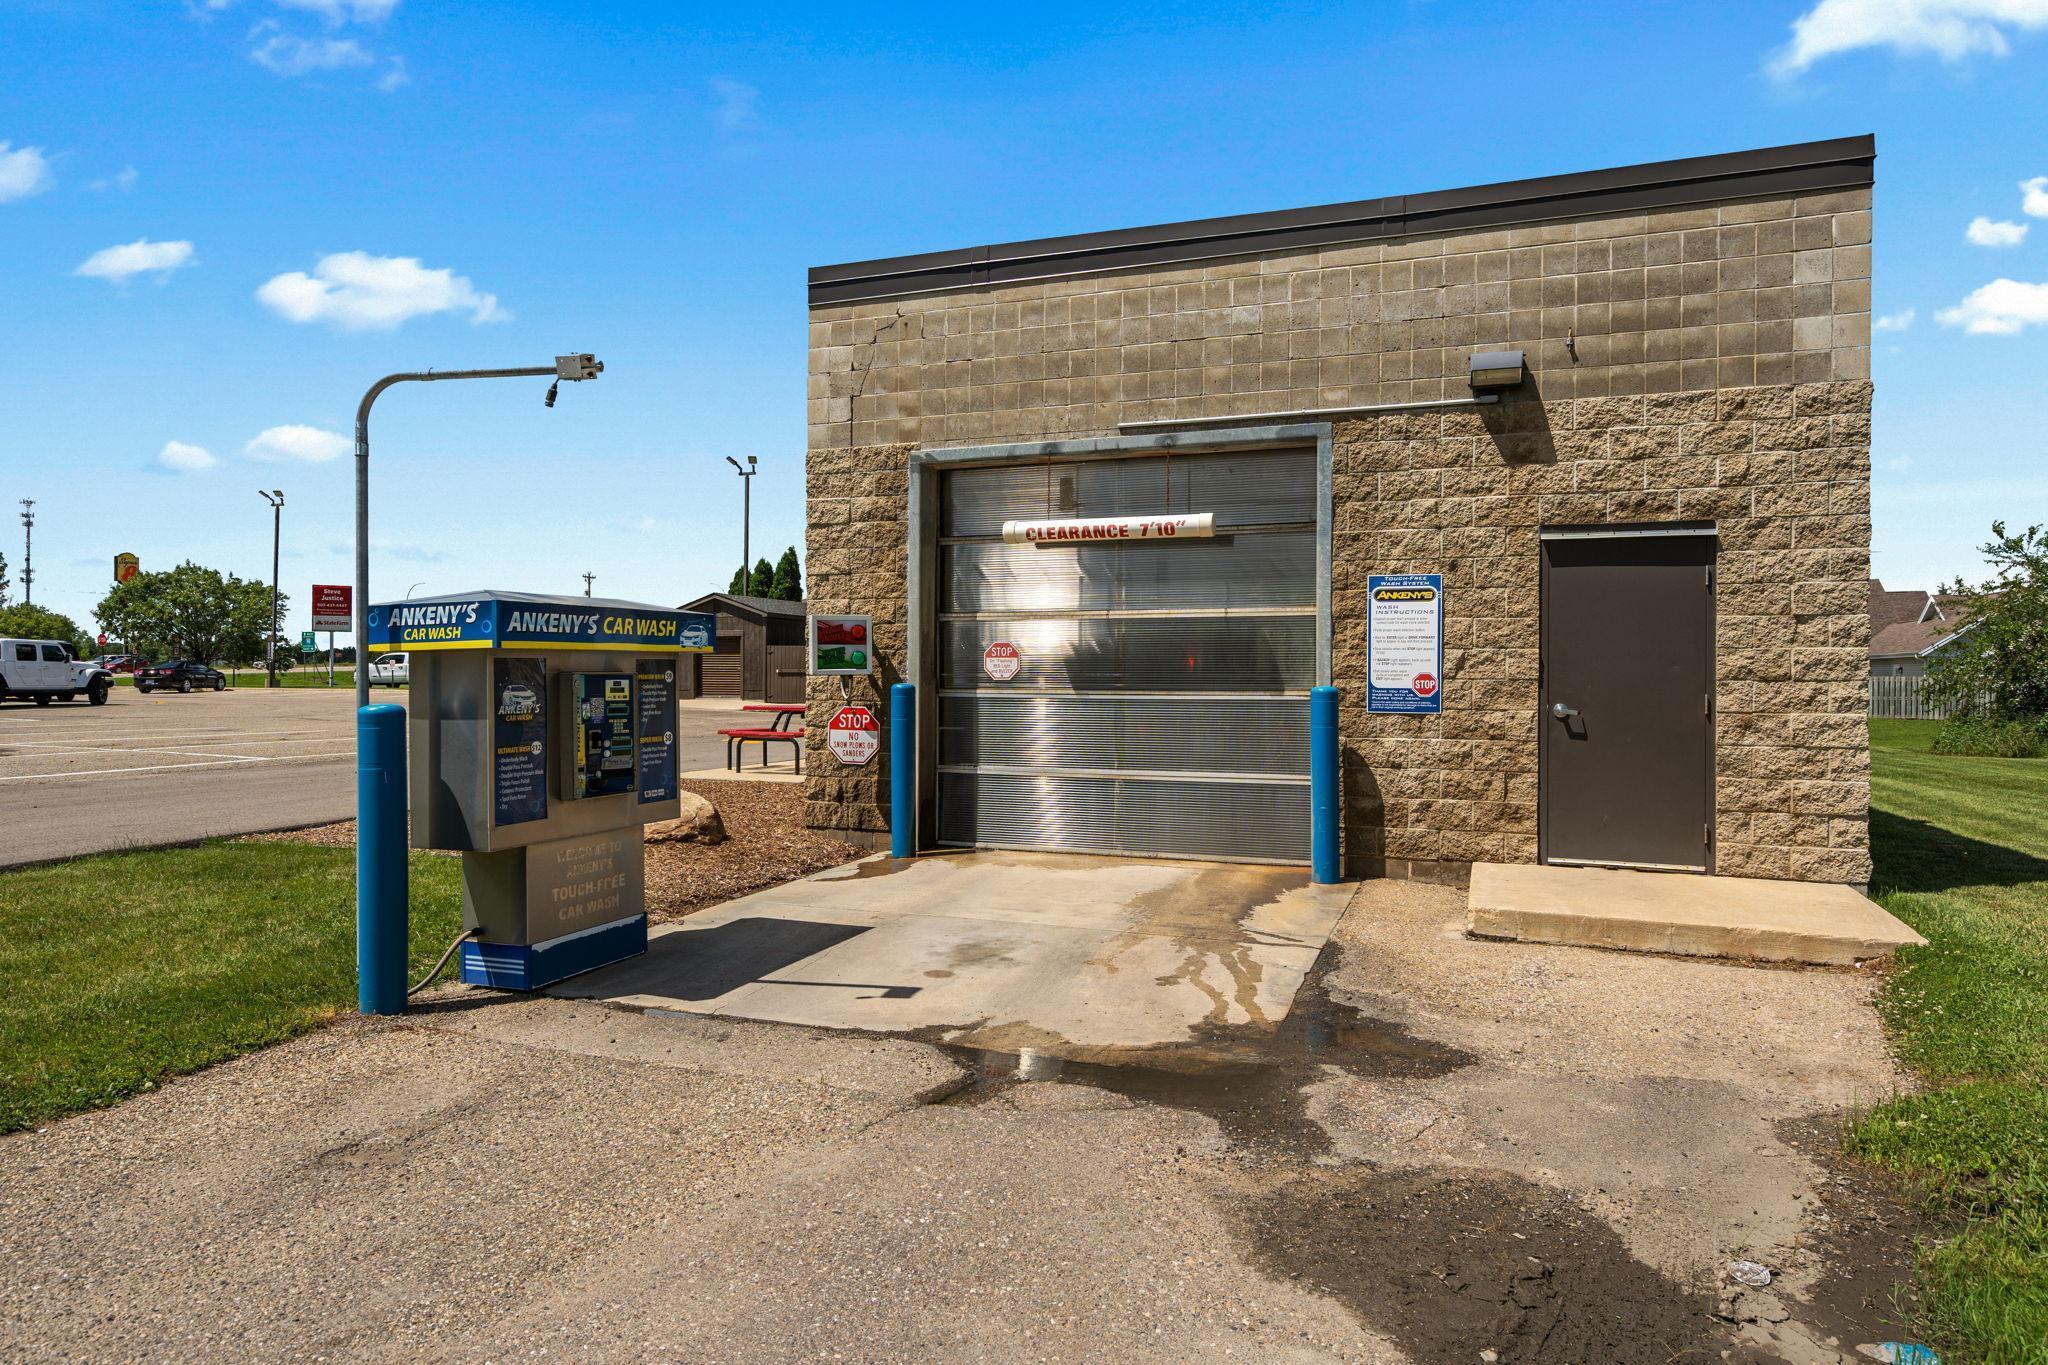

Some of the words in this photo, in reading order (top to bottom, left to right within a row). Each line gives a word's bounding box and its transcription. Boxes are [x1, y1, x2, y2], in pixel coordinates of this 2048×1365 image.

[1025, 524, 1129, 541] CLEARANCE
[1140, 520, 1186, 537] 7'10"
[1377, 590, 1433, 600] ANKENY'S
[388, 602, 479, 628] ANKENY'S
[507, 611, 599, 635] ANKENY'S
[603, 616, 634, 635] CAR
[637, 619, 677, 637] WASH
[403, 628, 426, 641] CAR
[428, 626, 462, 640] WASH
[991, 647, 1013, 657] STOP
[1415, 680, 1435, 689] STOP
[498, 703, 541, 715] ANKENY'S
[517, 713, 533, 721] WASH
[839, 714, 870, 728] STOP
[848, 732, 859, 741] NO
[497, 746, 519, 754] ULTIMATE
[531, 743, 541, 753] $12
[608, 840, 622, 853] TO
[552, 873, 627, 902] TOUCH-FREE
[559, 903, 584, 920] CAR
[587, 893, 620, 914] WASH
